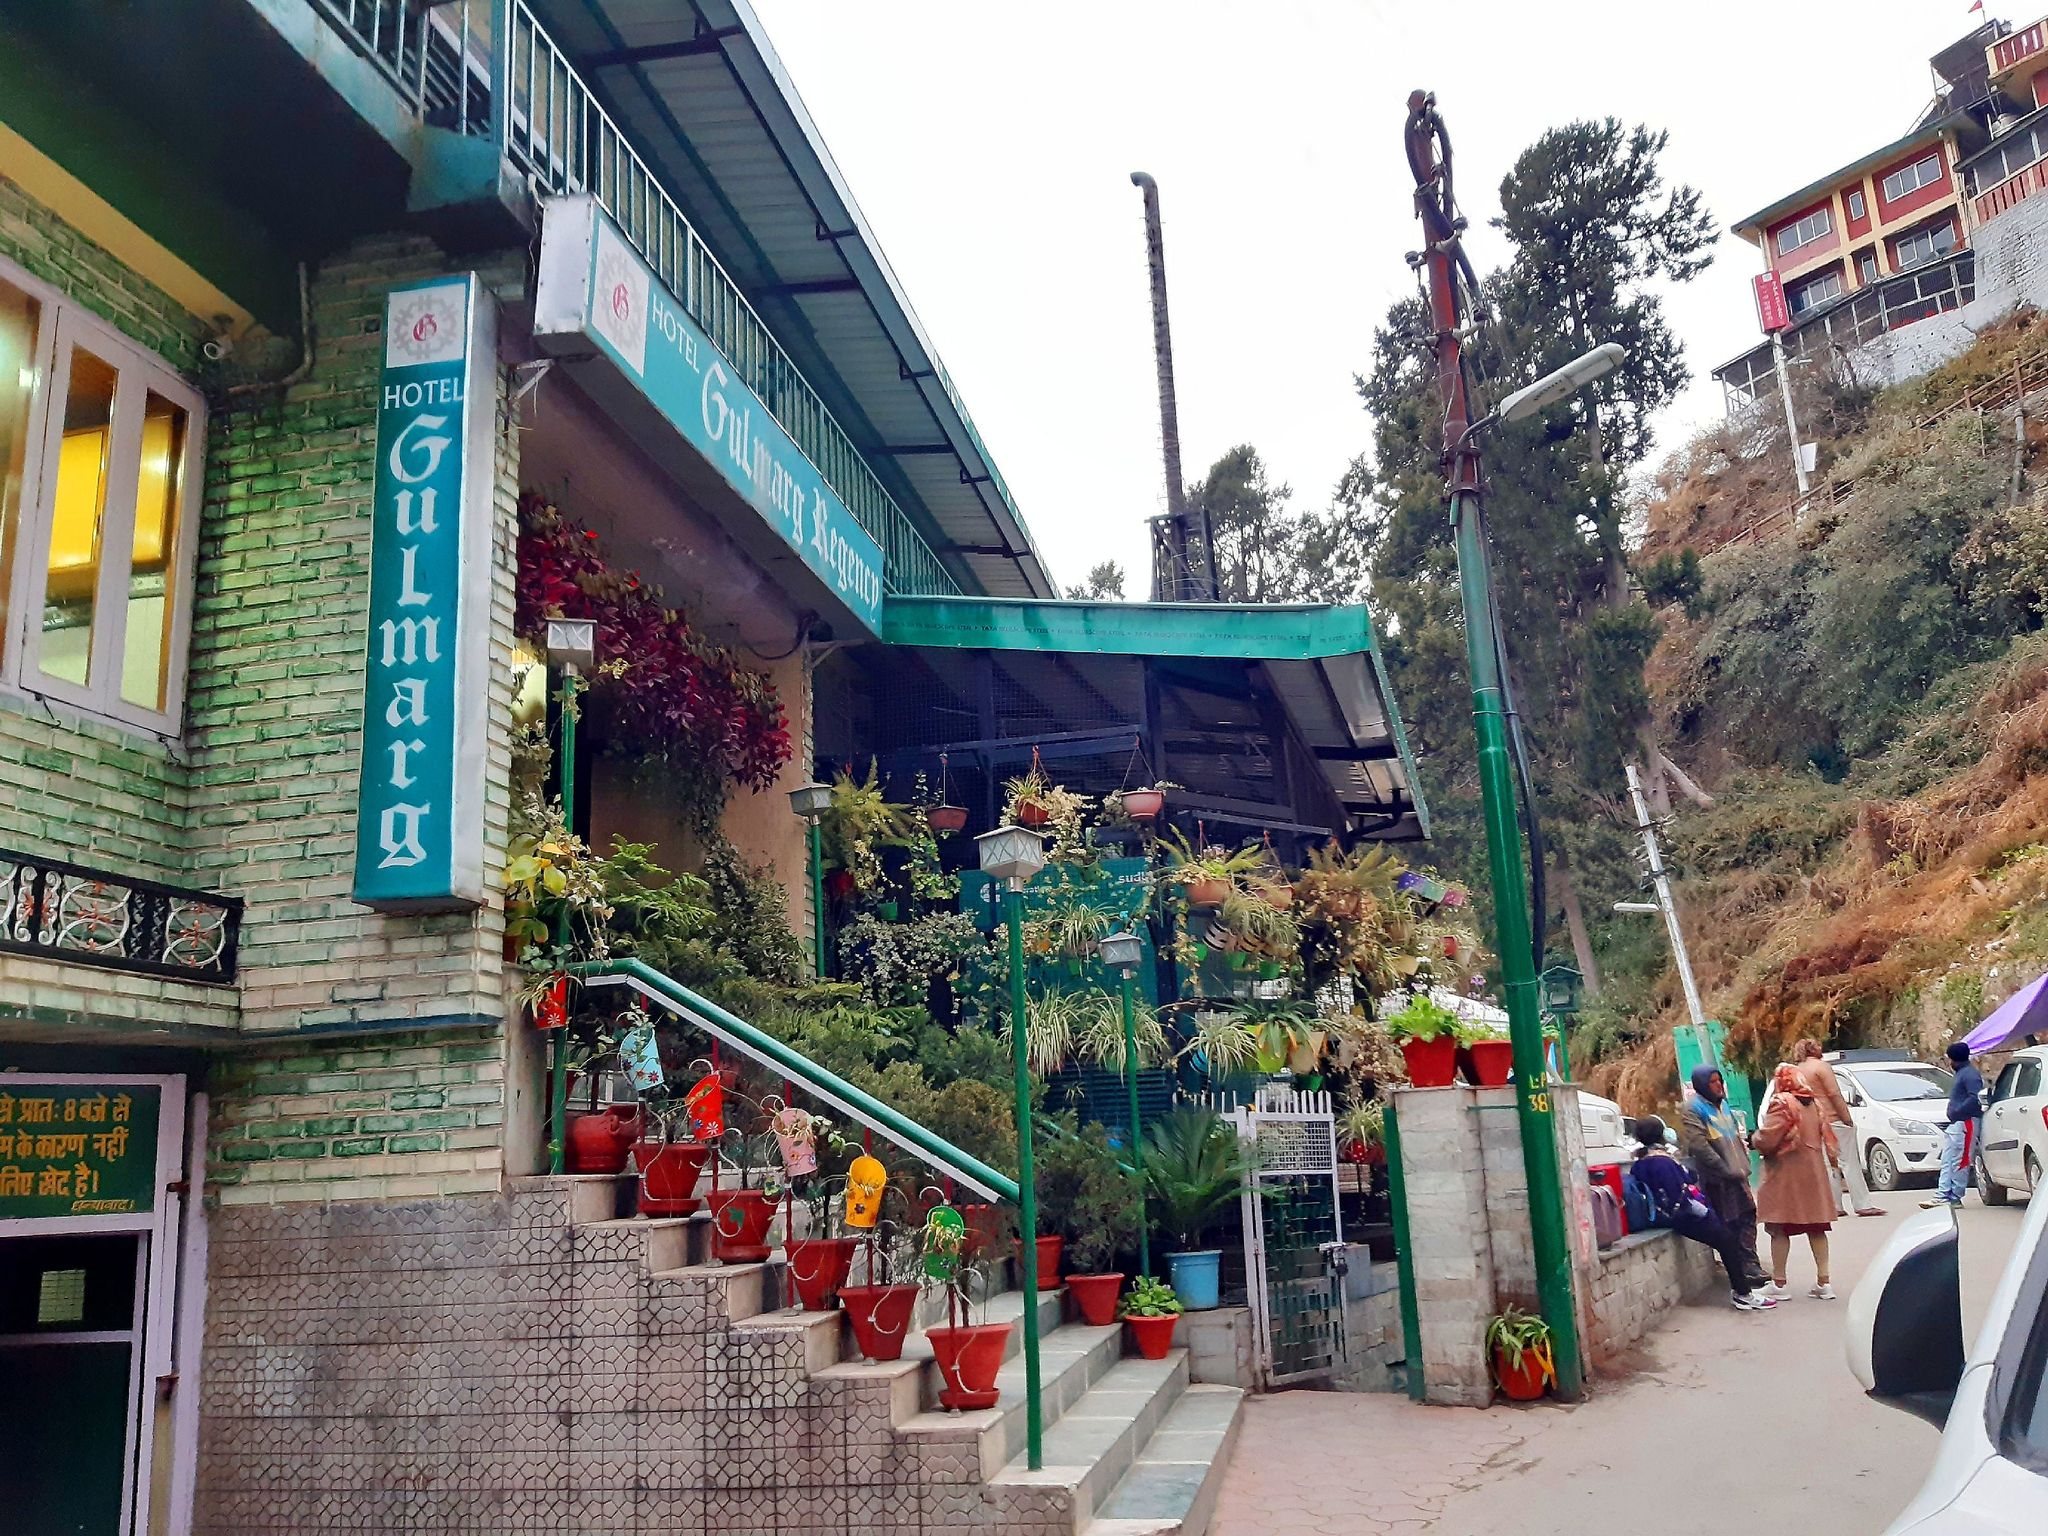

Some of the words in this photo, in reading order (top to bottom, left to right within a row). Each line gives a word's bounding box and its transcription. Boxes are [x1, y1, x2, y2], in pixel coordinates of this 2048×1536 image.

[384, 377, 464, 410] HOTEL
[652, 294, 700, 374] HOTEL
[811, 486, 879, 623] Regency
[64, 1098, 76, 1122] 8
[79, 1092, 109, 1122] बजे
[112, 1093, 131, 1122] से
[16, 1128, 34, 1159] के
[35, 1133, 88, 1160] कारण
[93, 1126, 129, 1162] नहीं
